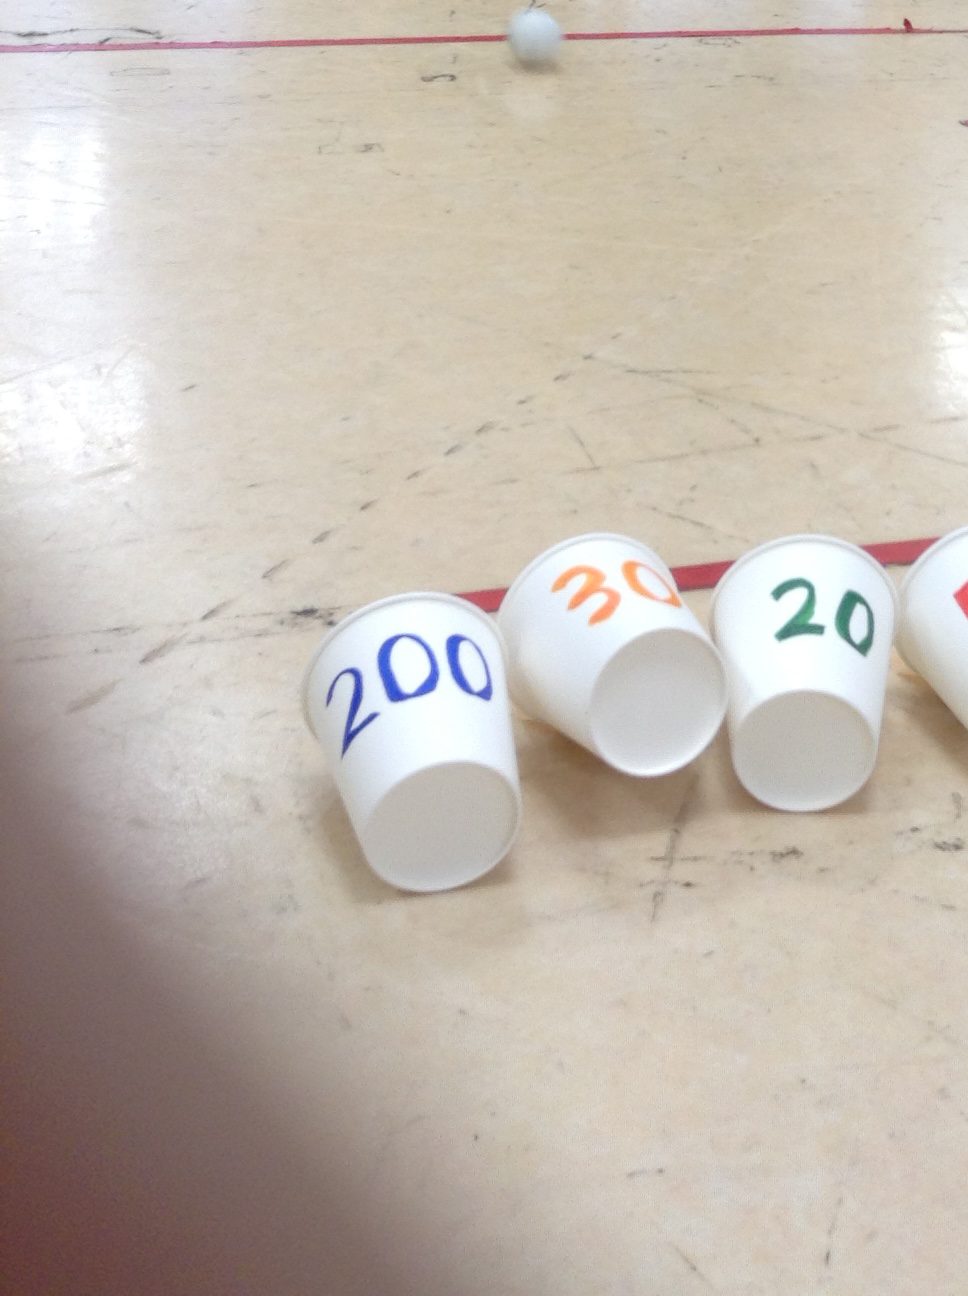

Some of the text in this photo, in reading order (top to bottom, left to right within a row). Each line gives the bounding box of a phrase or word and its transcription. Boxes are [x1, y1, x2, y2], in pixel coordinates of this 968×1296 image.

[551, 559, 682, 627] 30
[771, 577, 875, 657] 20
[326, 633, 493, 760] 200
